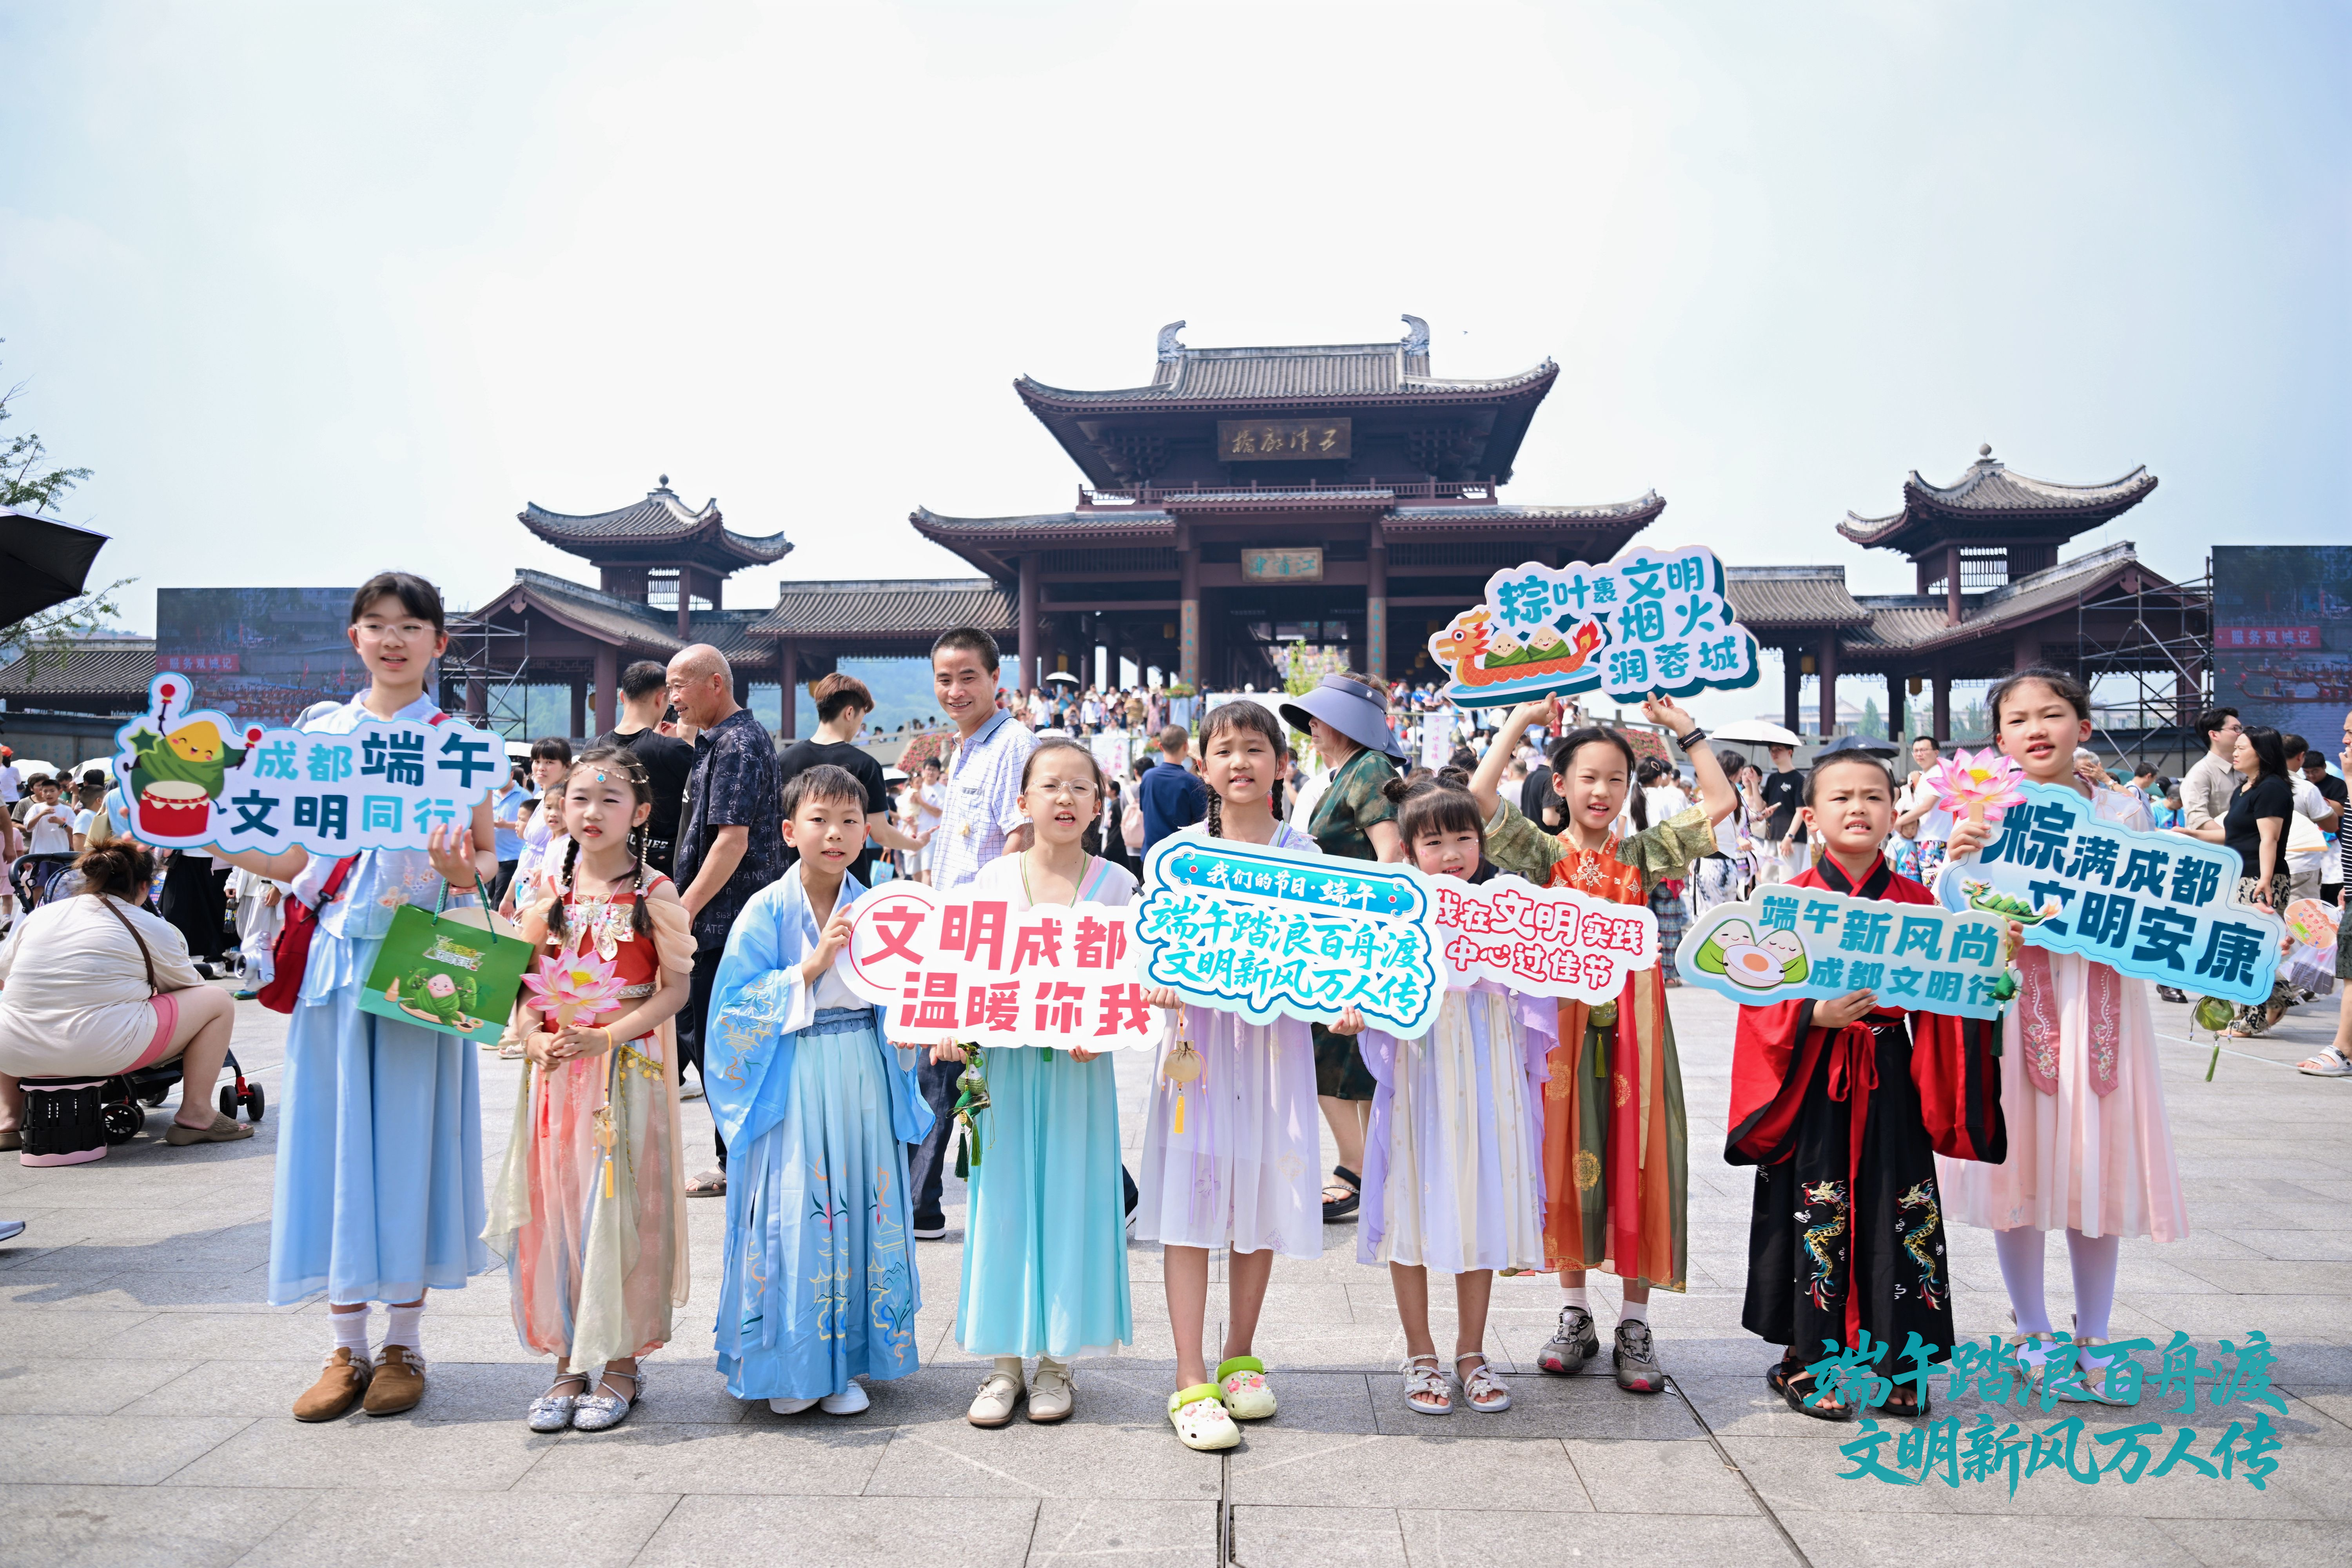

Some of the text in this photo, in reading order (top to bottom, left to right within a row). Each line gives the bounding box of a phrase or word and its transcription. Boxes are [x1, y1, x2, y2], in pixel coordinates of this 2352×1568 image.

[1497, 556, 1704, 627] 粽叶裹文明
[1618, 594, 1715, 645] 烟火
[169, 657, 232, 670] 服务双城记
[1608, 636, 1739, 685] 润蓉城
[2231, 630, 2311, 645] 服务双城记
[254, 730, 494, 788] 成都端午
[230, 789, 456, 840] 文明同行
[1980, 802, 2222, 908] 粽满成都
[1206, 861, 1377, 911] 我们的节日·端午
[861, 901, 1127, 975] 文明成都
[1147, 895, 1425, 979] 端午踏浪百舟渡
[1435, 888, 1644, 956] 我在文明实践
[1759, 895, 1999, 968] 端午新风尚
[2028, 880, 2266, 987] 文明安康
[1161, 942, 1420, 1016] 文明新风万人传
[1445, 935, 1614, 991] 中心过佳节
[1808, 956, 2001, 1007] 成都文明行
[900, 971, 1151, 1036] 温暖你我
